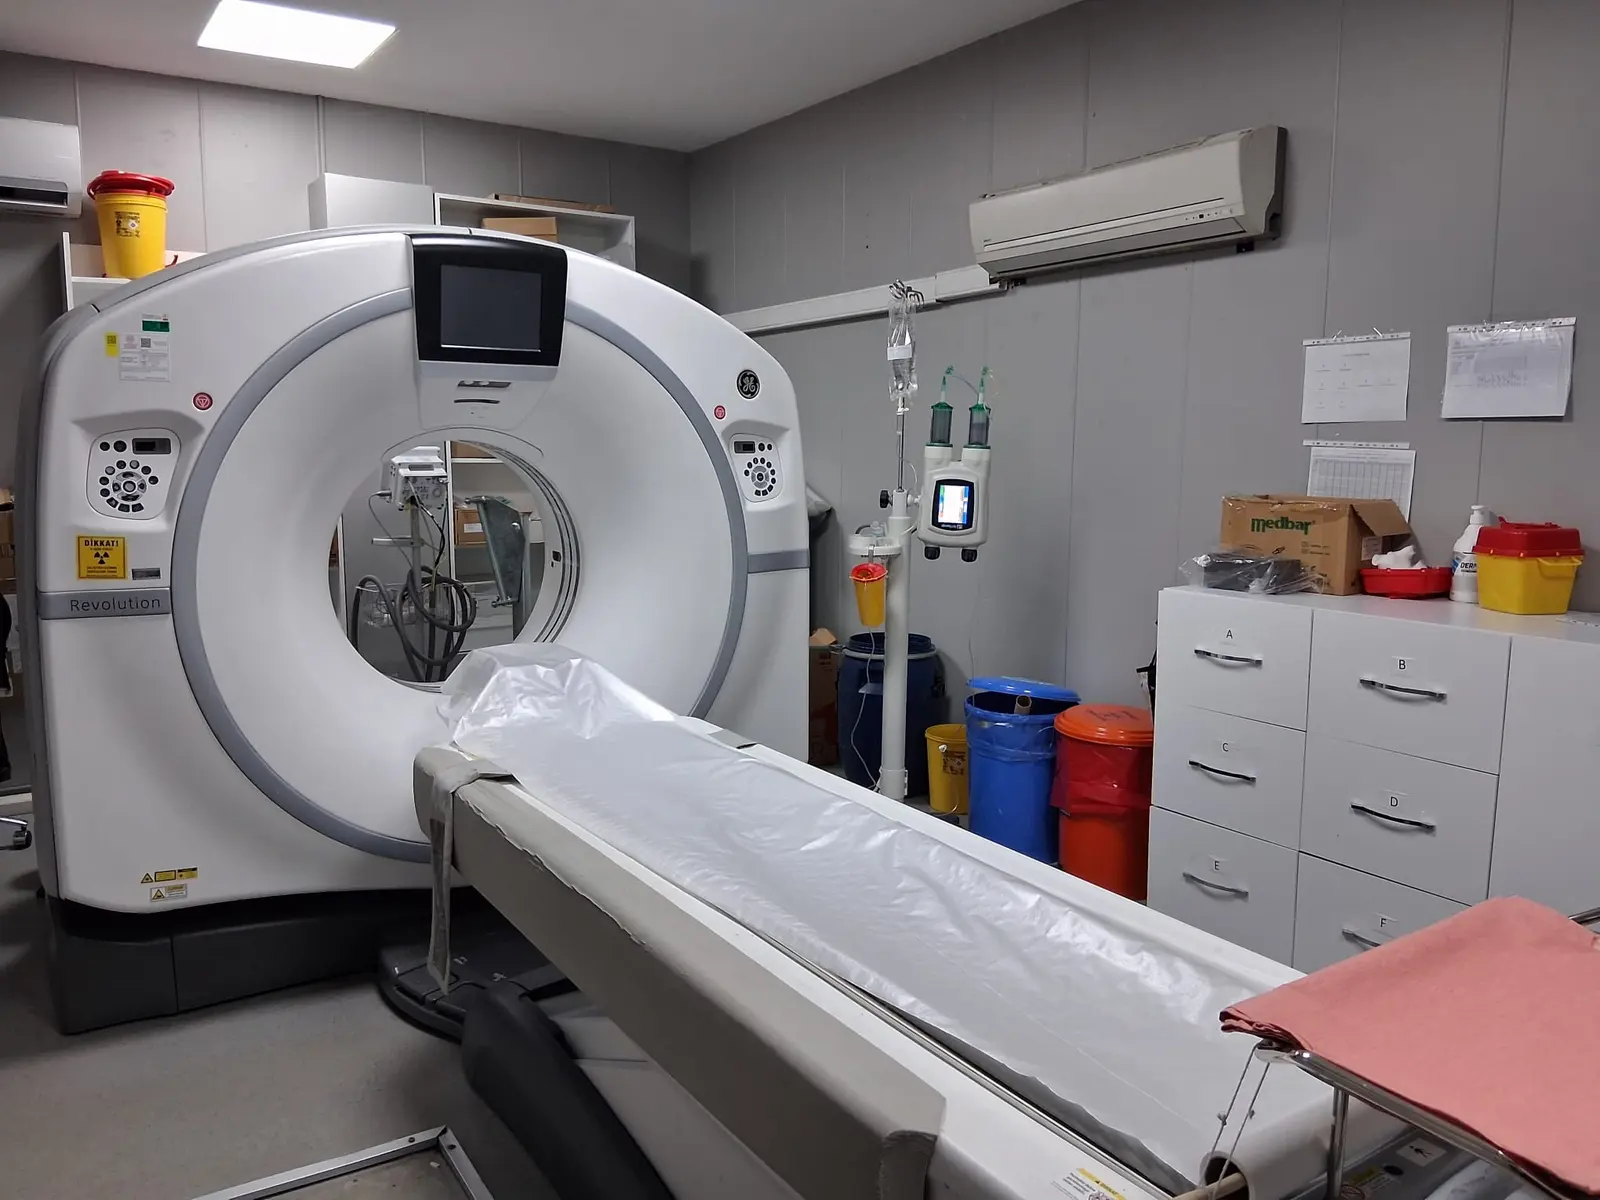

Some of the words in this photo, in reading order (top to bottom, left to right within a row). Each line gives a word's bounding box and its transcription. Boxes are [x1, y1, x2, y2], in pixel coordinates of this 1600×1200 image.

[1251, 516, 1312, 535] medbar
[84, 538, 119, 547] DİKKAT!
[70, 597, 161, 612] Revolution
[1225, 629, 1233, 639] A
[1398, 659, 1406, 670] B
[1222, 742, 1229, 752] C
[1390, 796, 1399, 807] D
[1214, 860, 1220, 871] E
[1380, 918, 1387, 928] F
